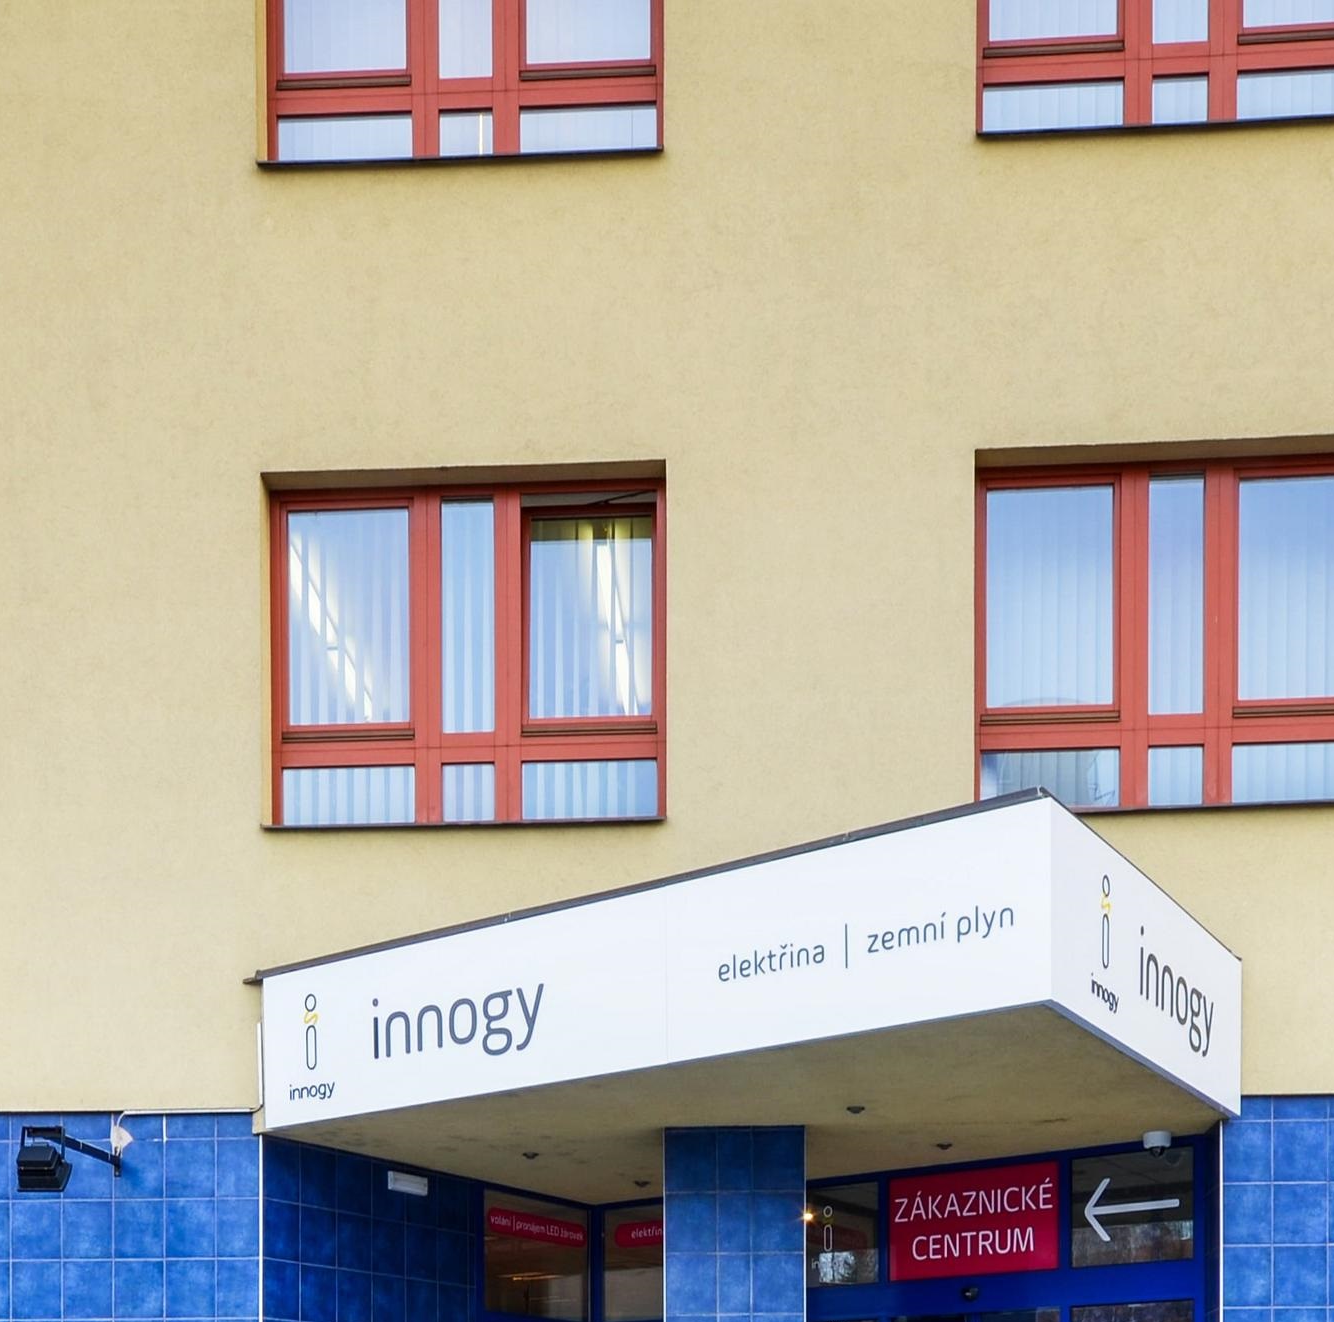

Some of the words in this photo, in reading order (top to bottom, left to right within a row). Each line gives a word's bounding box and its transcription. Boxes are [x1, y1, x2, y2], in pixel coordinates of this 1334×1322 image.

[718, 943, 826, 983] elektřina
[867, 911, 947, 954] zemní
[956, 905, 1015, 943] plyn
[1090, 971, 1120, 1014] innogy
[1139, 924, 1215, 1058] innogy
[371, 982, 545, 1060] innogy
[288, 1081, 336, 1101] innogy
[894, 1176, 1054, 1223] ZÁKAZNICKÉ
[912, 1226, 1035, 1261] CENTRUM
